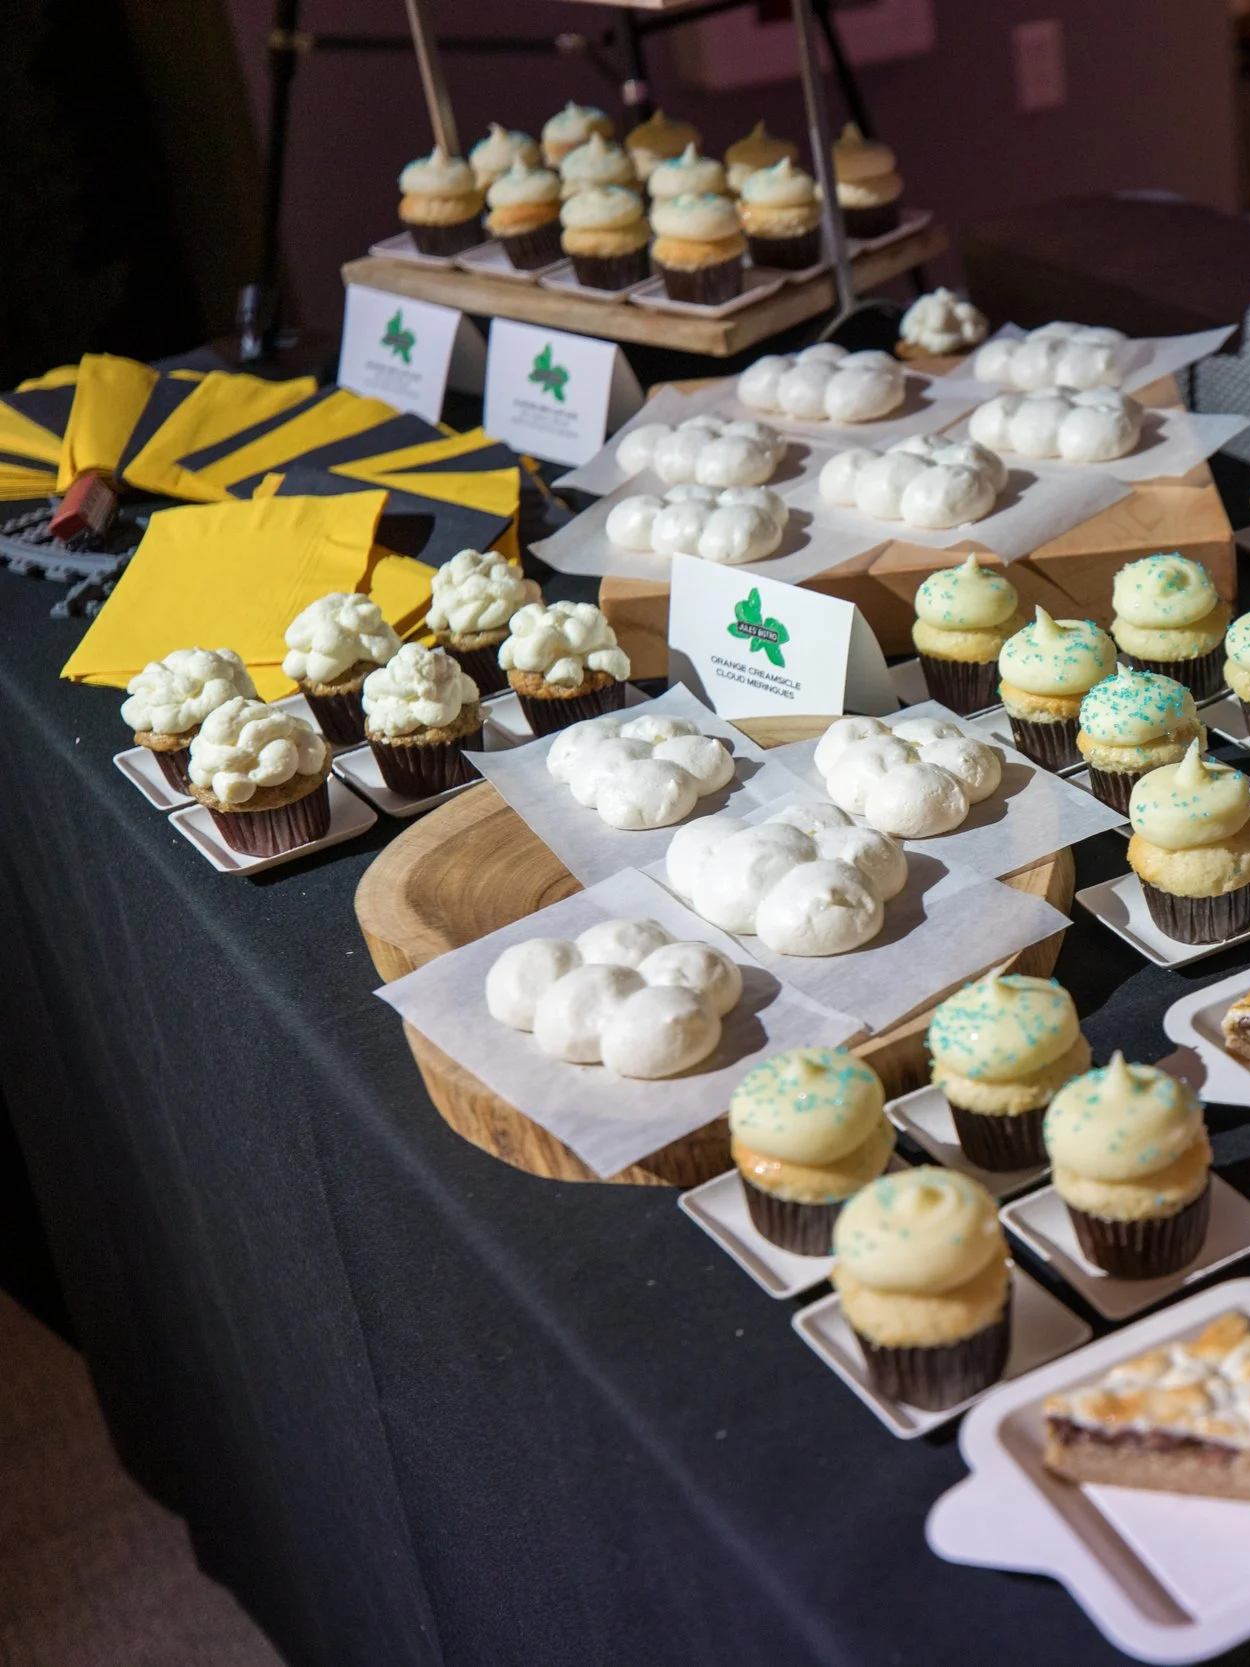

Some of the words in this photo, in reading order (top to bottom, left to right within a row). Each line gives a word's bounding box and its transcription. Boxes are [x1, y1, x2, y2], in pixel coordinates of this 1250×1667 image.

[739, 622, 757, 635] JULES
[757, 629, 778, 641] BISTRO
[711, 656, 746, 672] ORANGE
[748, 666, 801, 690] CREAMSICLE
[716, 669, 745, 683] CLOUD
[747, 679, 795, 699] MERINGUES
